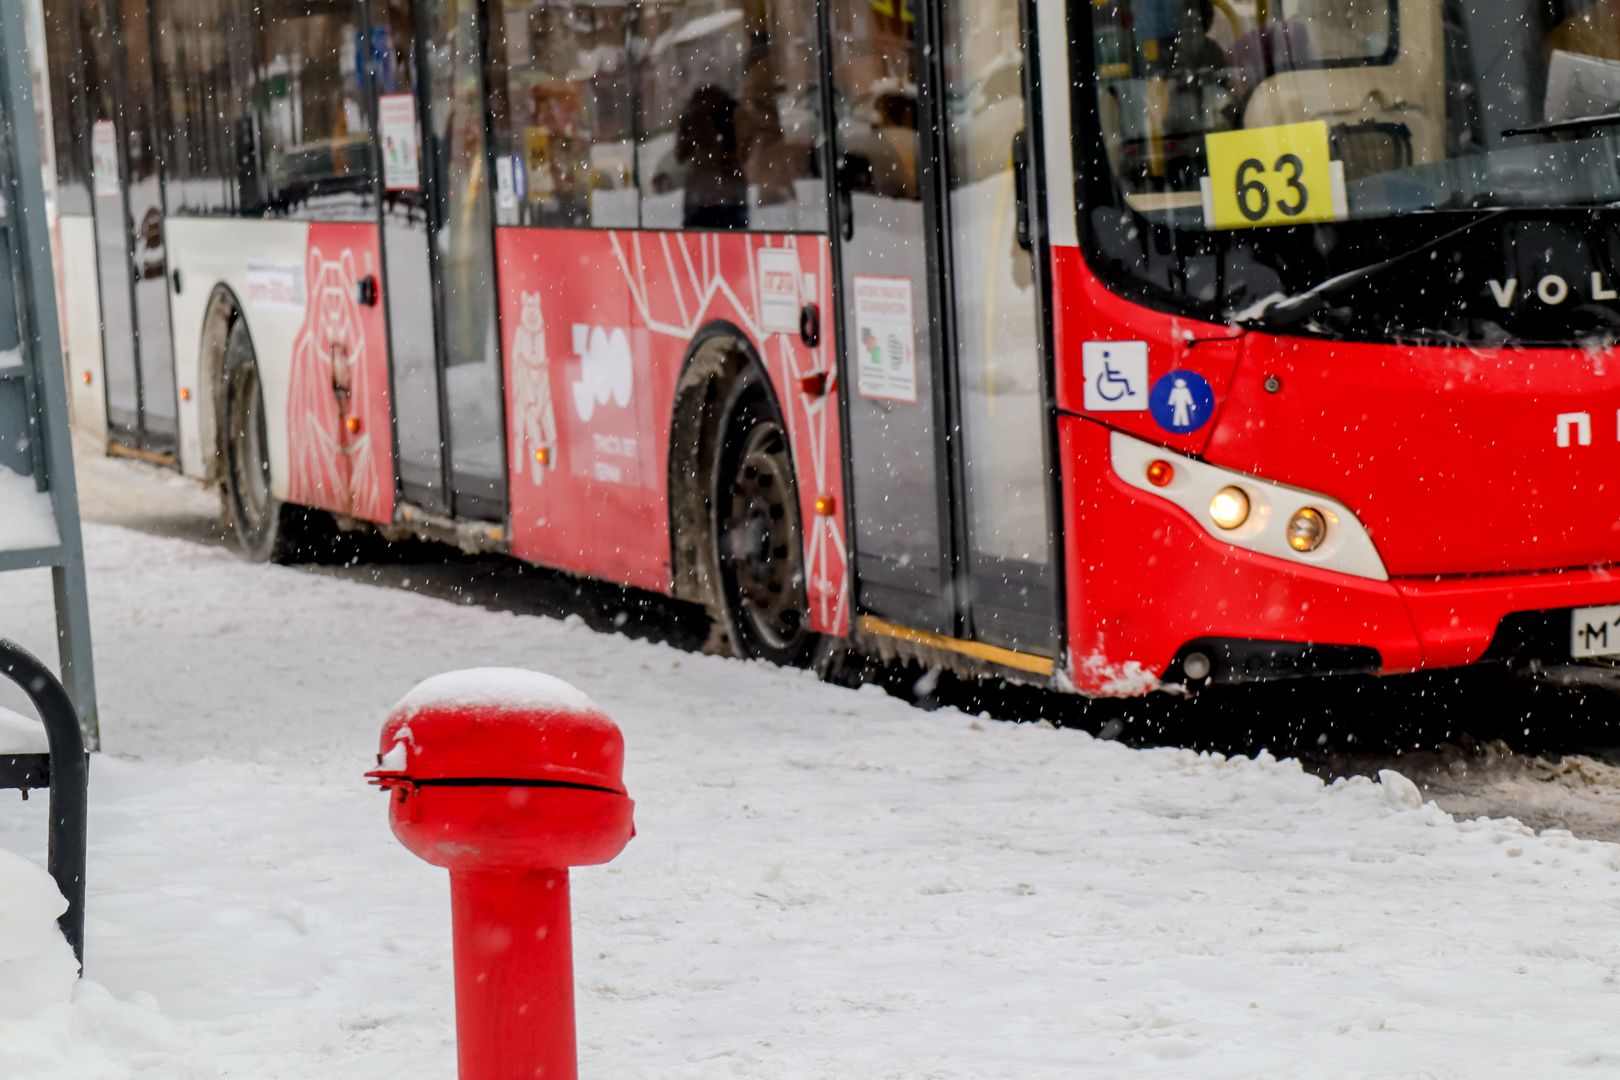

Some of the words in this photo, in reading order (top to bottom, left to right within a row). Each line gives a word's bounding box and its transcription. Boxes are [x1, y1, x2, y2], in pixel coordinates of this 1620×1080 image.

[1235, 153, 1308, 221] 63
[1488, 271, 1617, 308] VOL
[1556, 408, 1620, 448] П
